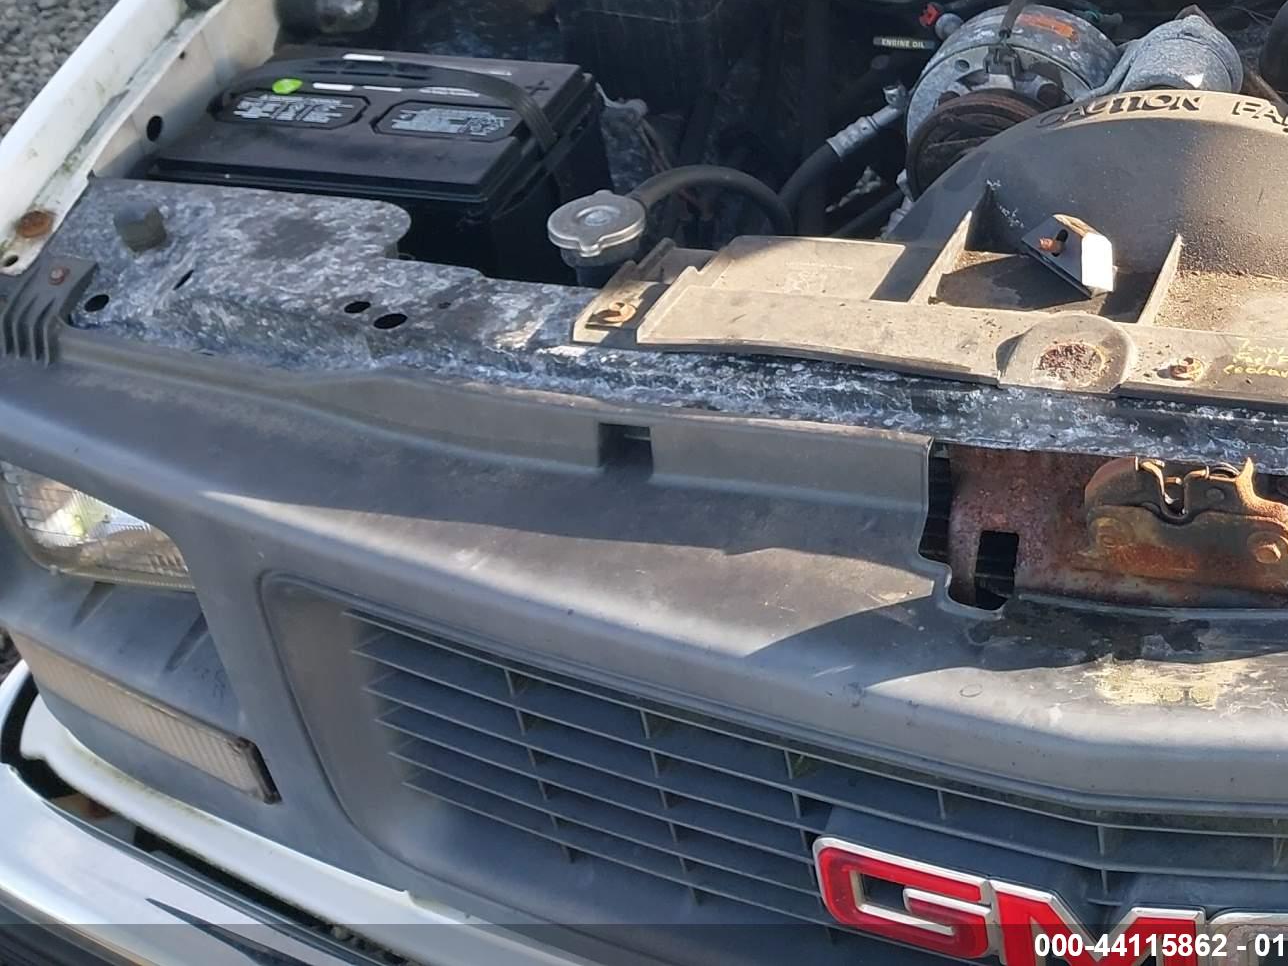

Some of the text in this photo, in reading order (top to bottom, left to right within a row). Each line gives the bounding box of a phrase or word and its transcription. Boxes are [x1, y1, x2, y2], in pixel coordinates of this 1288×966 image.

[881, 37, 926, 50] ENGINE OIL
[1036, 94, 1201, 129] CAUTION
